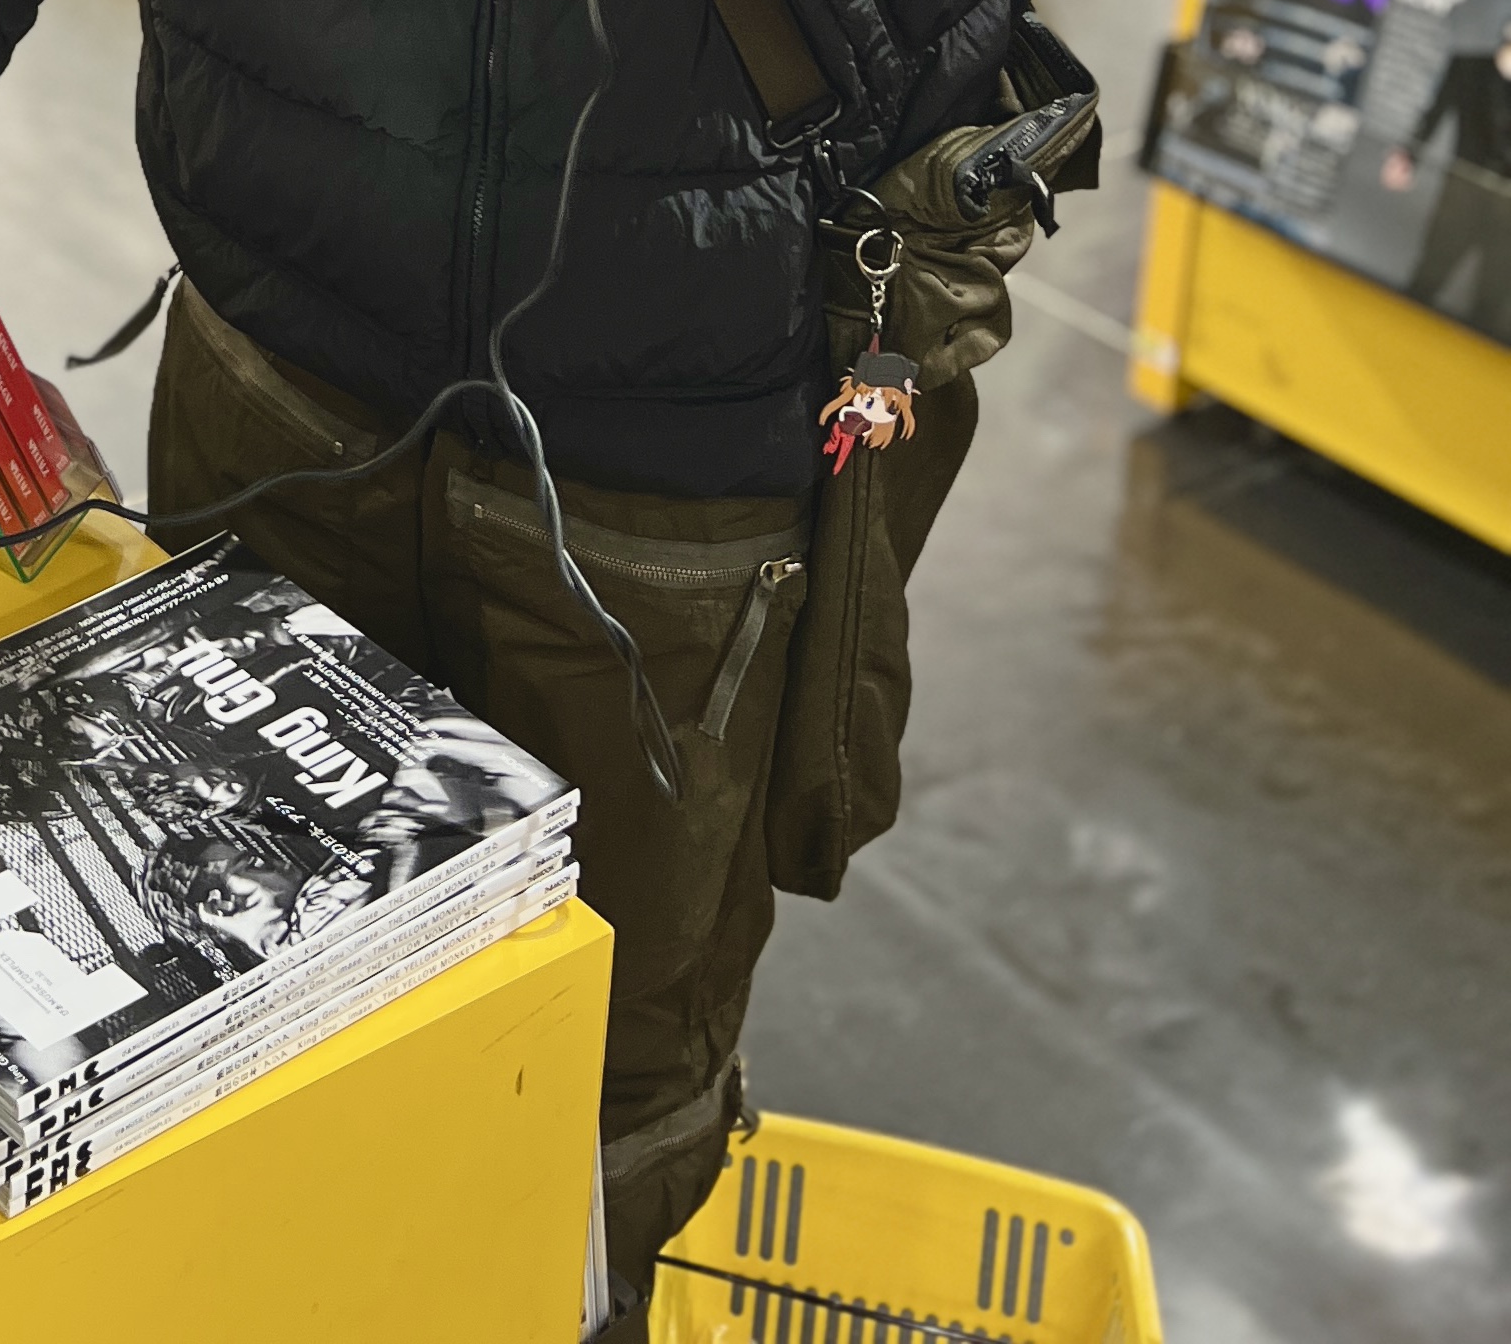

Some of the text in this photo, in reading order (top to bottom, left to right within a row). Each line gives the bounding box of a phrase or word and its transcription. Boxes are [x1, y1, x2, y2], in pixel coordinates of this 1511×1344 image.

[167, 639, 389, 809] King Gnu
[33, 850, 479, 1112] PMC King Gnu imase THE YELLOW MONKEY
[39, 868, 479, 1137] PMC King Gnu imase THE YELLOW MONKEY
[279, 1007, 298, 1023] King
[302, 995, 318, 1010] Gnu
[329, 975, 354, 995] imase
[366, 960, 380, 974] THE
[386, 936, 421, 962] YELLOW
[423, 915, 458, 941] MONKEY
[285, 898, 465, 1004] King Gnu imase THE YELLOW MONKEY
[296, 941, 474, 1050] King Gnu imase THE YELLOW MONKEY
[298, 925, 476, 1033] King Gnu imase THE YELLOW MONKEY
[2, 1063, 34, 1084] King
